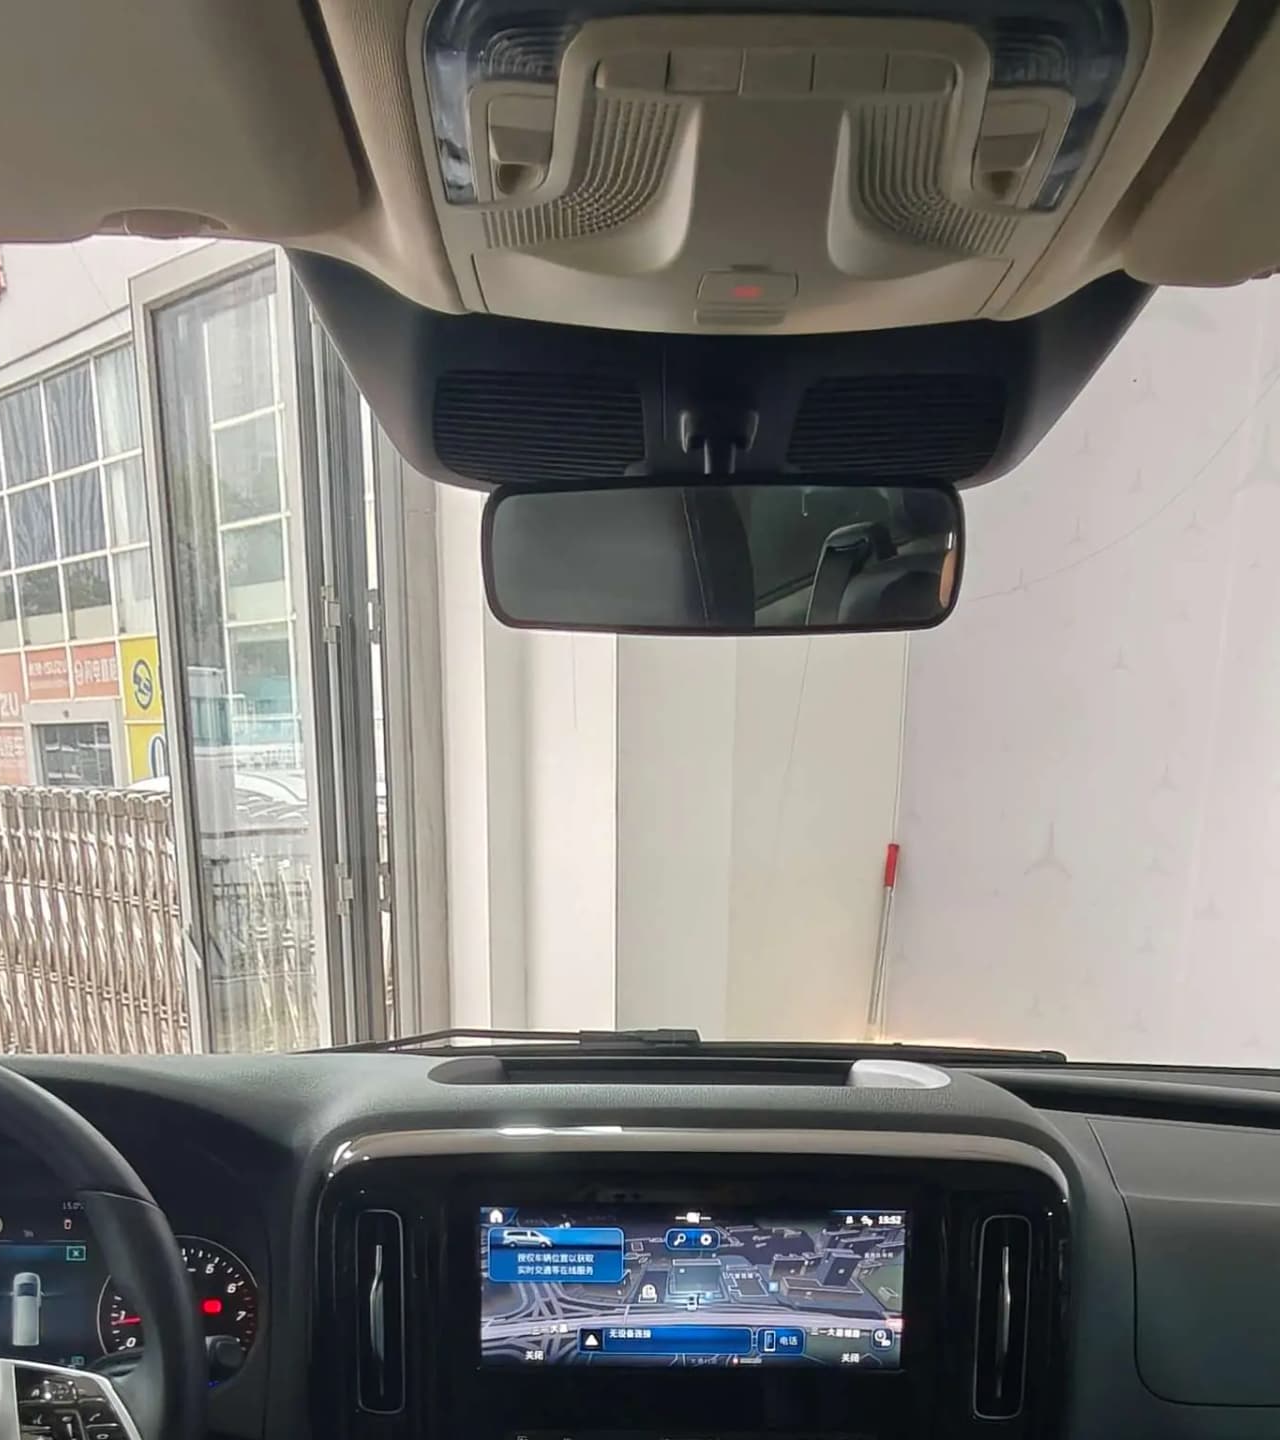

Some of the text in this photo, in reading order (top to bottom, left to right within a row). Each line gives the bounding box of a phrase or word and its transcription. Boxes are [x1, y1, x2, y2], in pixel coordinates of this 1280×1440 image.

[878, 1215, 902, 1225] 15:52
[205, 1263, 215, 1275] 5
[227, 1282, 237, 1294] 6
[119, 1310, 126, 1321] 1
[236, 1311, 247, 1322] 7
[608, 1328, 652, 1339] 无设备连接
[125, 1337, 137, 1348] 0
[779, 1335, 798, 1346] 电话
[525, 1350, 544, 1361] 关闭
[841, 1353, 860, 1363] 关闭
